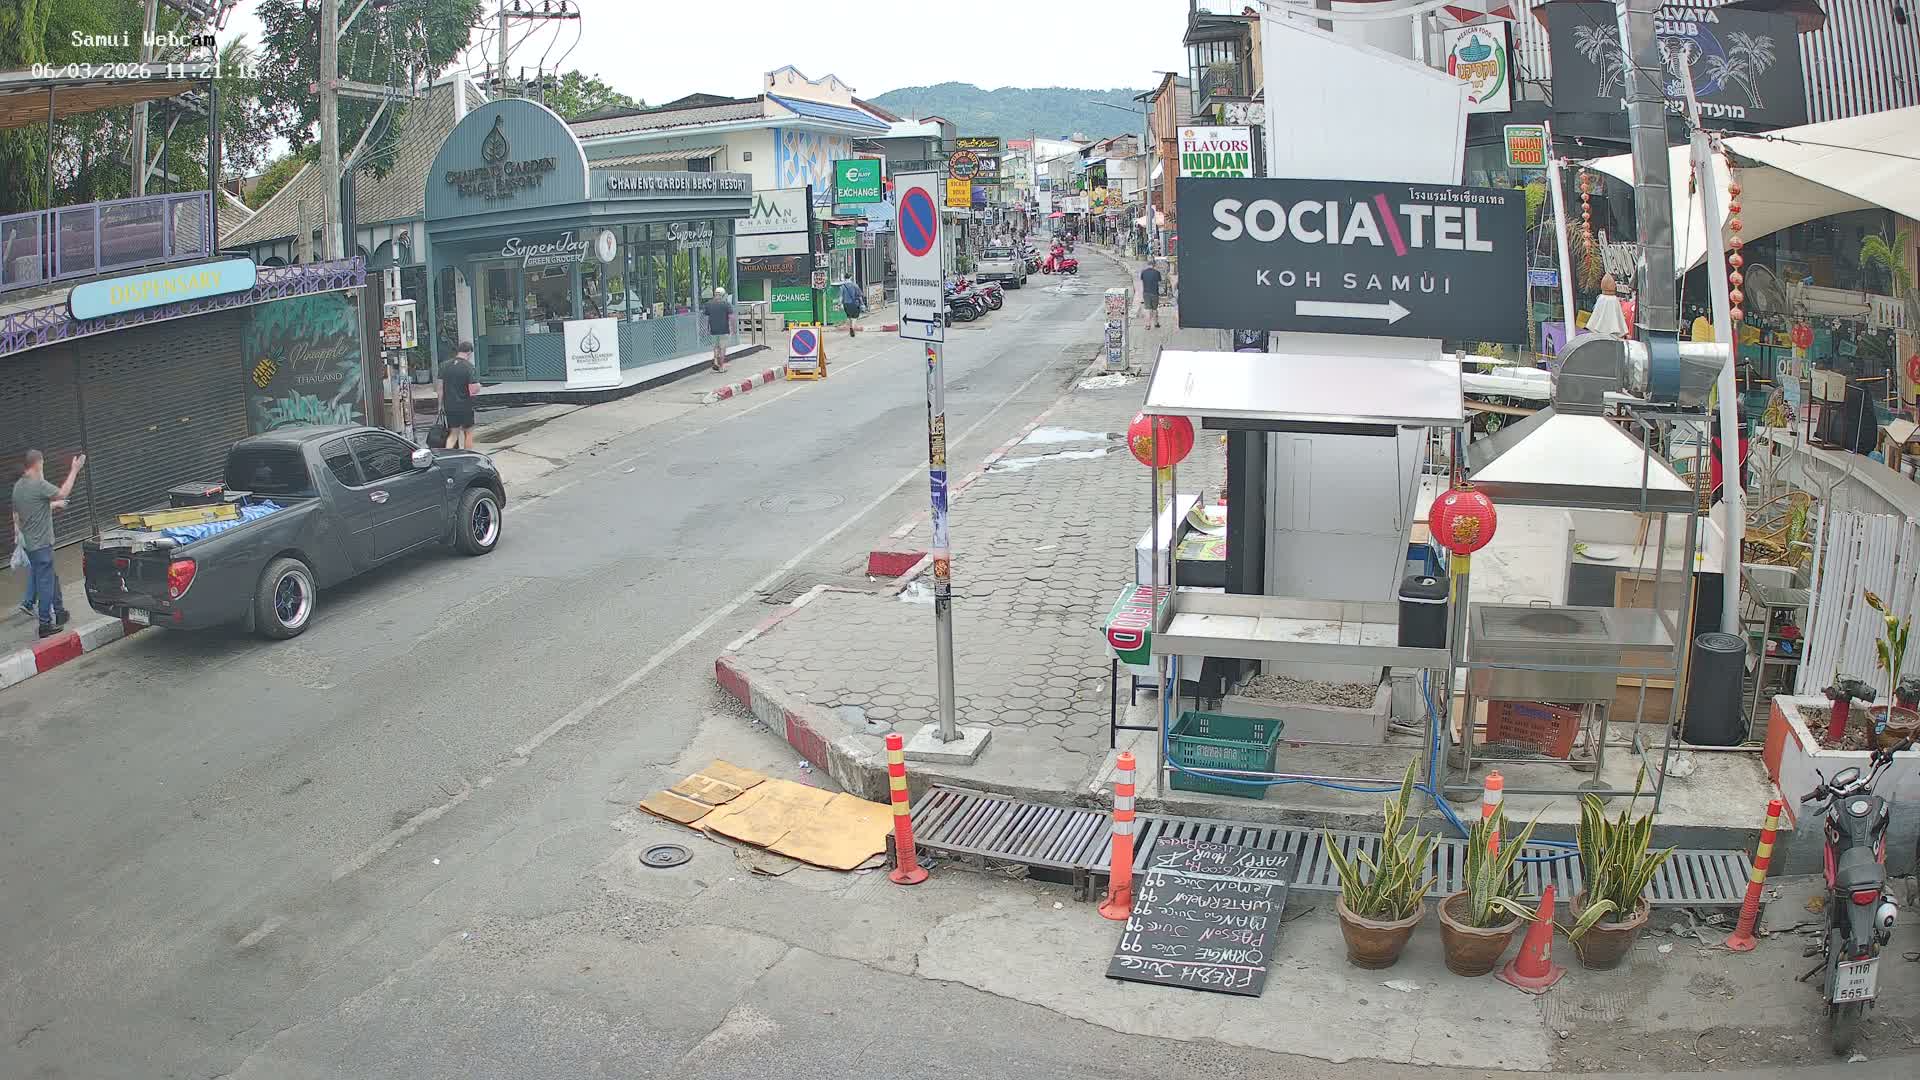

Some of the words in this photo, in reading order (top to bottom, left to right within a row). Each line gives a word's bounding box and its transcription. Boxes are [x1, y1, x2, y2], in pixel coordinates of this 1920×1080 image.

[1457, 27, 1478, 41] MEXICAN
[1479, 28, 1492, 38] FOOD
[1654, 21, 1698, 36] CLUB
[1184, 140, 1248, 152] FLAVORS
[1509, 137, 1542, 149] INDIAN
[1183, 153, 1248, 169] INDIAN
[1511, 150, 1542, 163] FOOD
[610, 177, 654, 191] CHAWENG
[657, 177, 691, 191] GARDEN
[693, 177, 717, 191] BEACH
[720, 178, 747, 191] RESORT
[838, 187, 878, 197] EXCHANGE
[109, 271, 222, 305] DISPENSARY
[1256, 269, 1321, 288] KOH
[1343, 272, 1450, 294] SAMUI
[771, 293, 810, 302] EXCHANGE
[904, 297, 912, 306] NO
[913, 298, 936, 308] PARKING
[295, 372, 343, 385] THAILAND
[1233, 853, 1288, 868] HAPPY
[1145, 872, 1166, 887] 99
[1238, 868, 1278, 878] ONLY
[1139, 887, 1158, 902] 99
[1133, 901, 1153, 915] 99
[1126, 916, 1144, 931] 99
[1120, 932, 1143, 952] 99
[1195, 947, 1263, 964] ORANGE
[1181, 967, 1252, 988] FRESH
